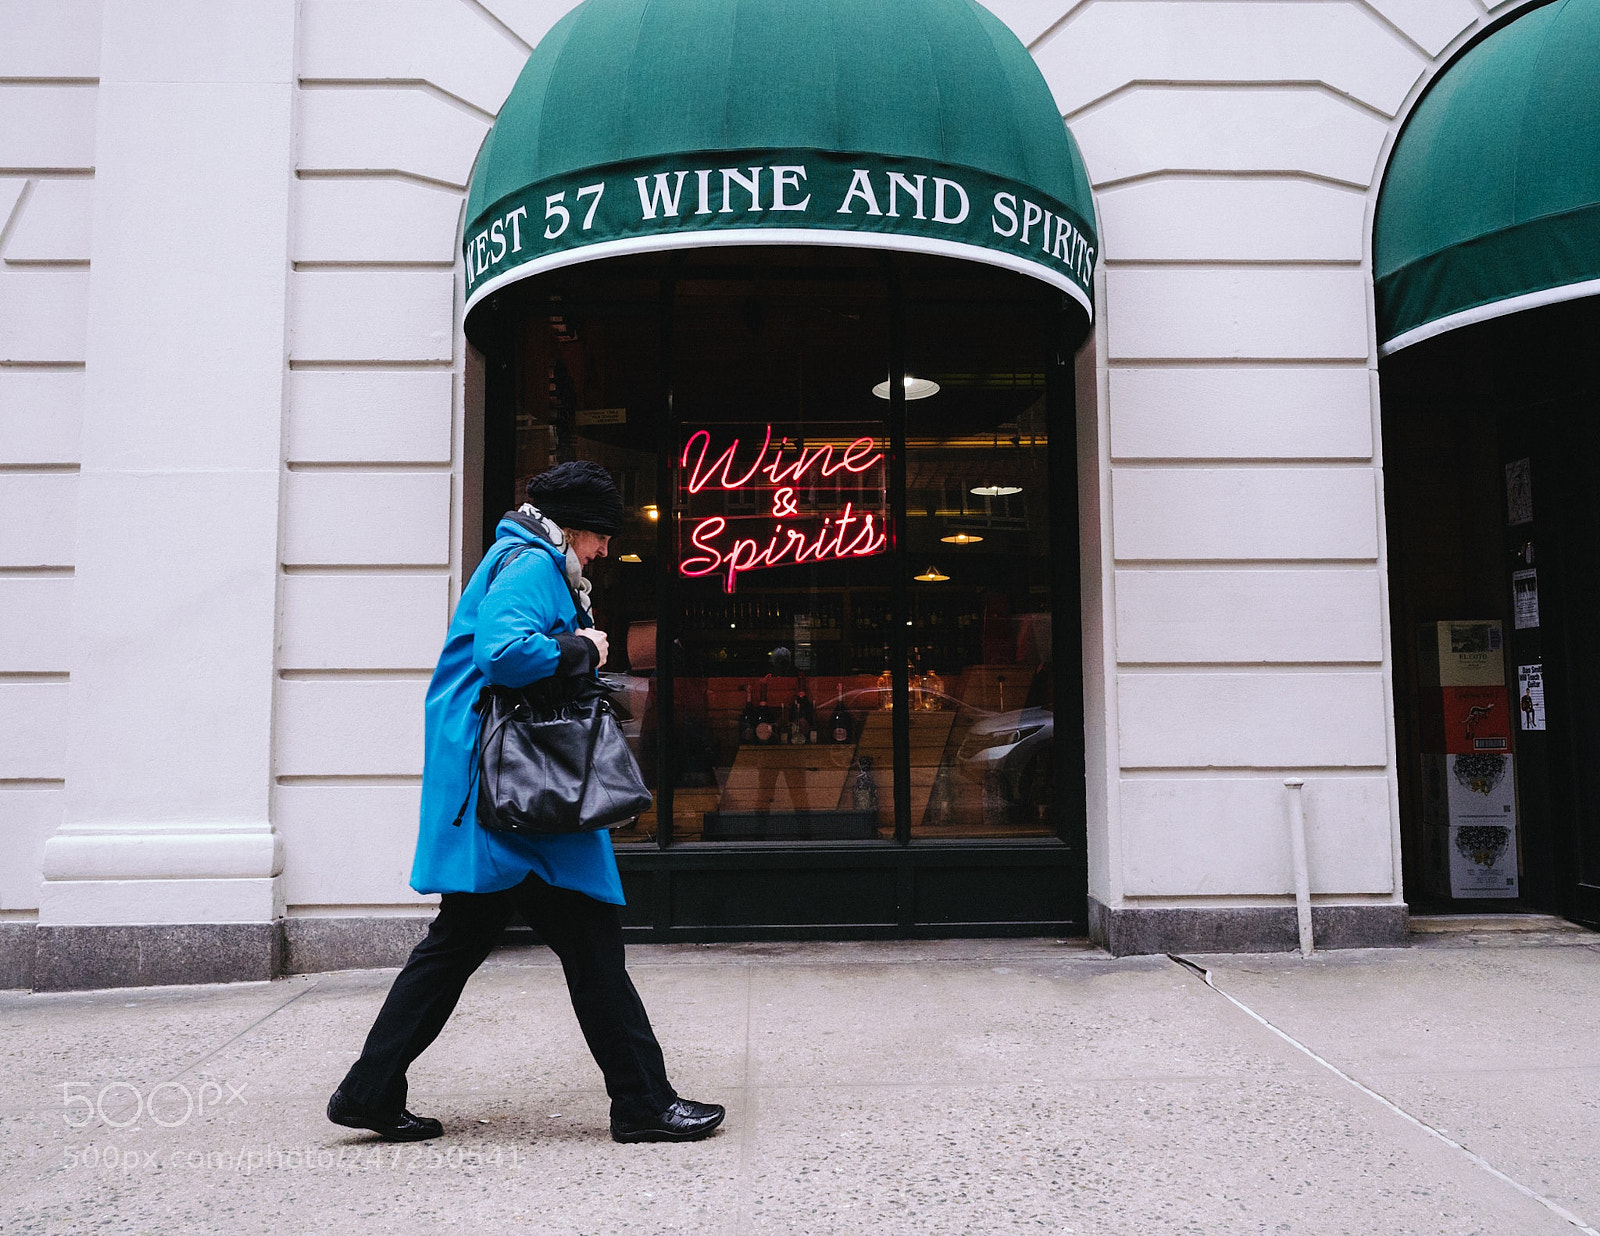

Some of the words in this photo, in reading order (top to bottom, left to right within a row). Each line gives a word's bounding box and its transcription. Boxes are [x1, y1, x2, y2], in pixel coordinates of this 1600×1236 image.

[466, 205, 527, 289] WEST
[543, 181, 605, 240] 57
[634, 165, 812, 220] WINE
[836, 169, 970, 225] AND
[991, 191, 1094, 288] SPIRITS
[682, 423, 884, 494] Wine
[772, 486, 798, 517] &
[680, 502, 886, 593] Spirits
